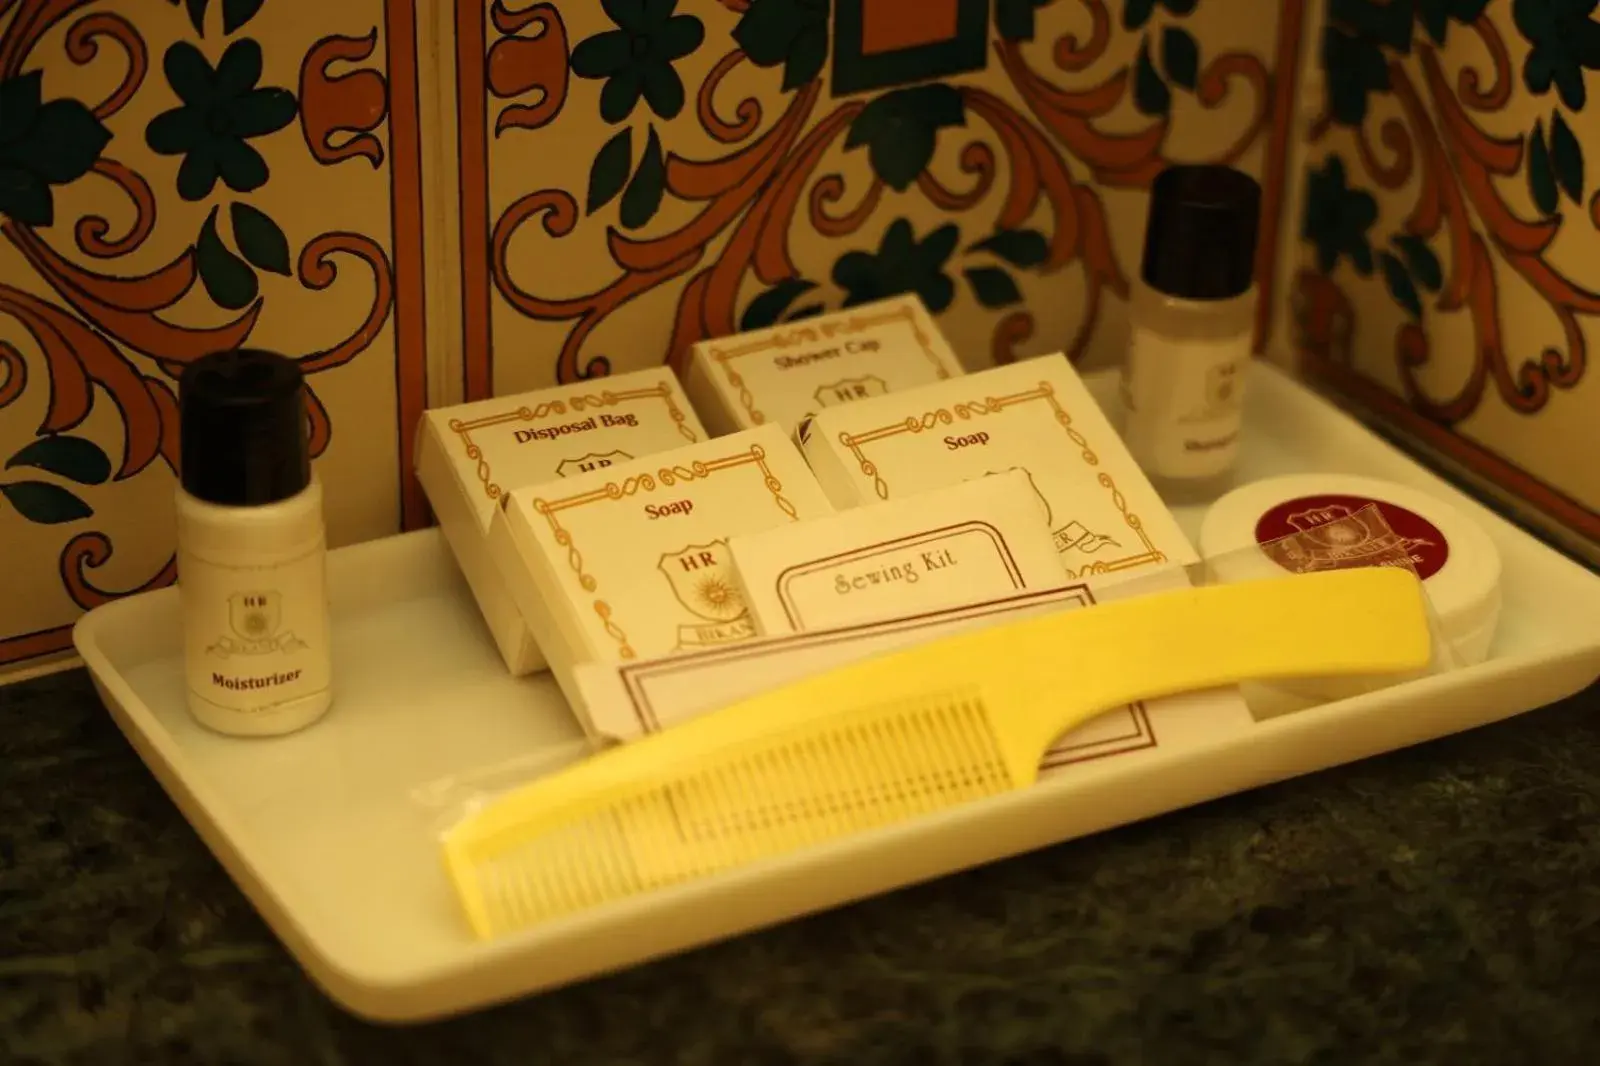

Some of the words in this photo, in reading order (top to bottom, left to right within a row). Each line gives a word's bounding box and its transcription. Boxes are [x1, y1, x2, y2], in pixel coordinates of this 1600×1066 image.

[774, 348, 841, 371] Shower
[845, 339, 881, 354] Cap
[513, 417, 597, 444] Disposal
[599, 413, 639, 428] Bag
[943, 431, 990, 451] Soap
[644, 499, 694, 520] Soap
[679, 551, 717, 572] HR
[834, 561, 919, 595] Sewing
[921, 548, 958, 572] Kit
[212, 668, 303, 691] Moisturizer
